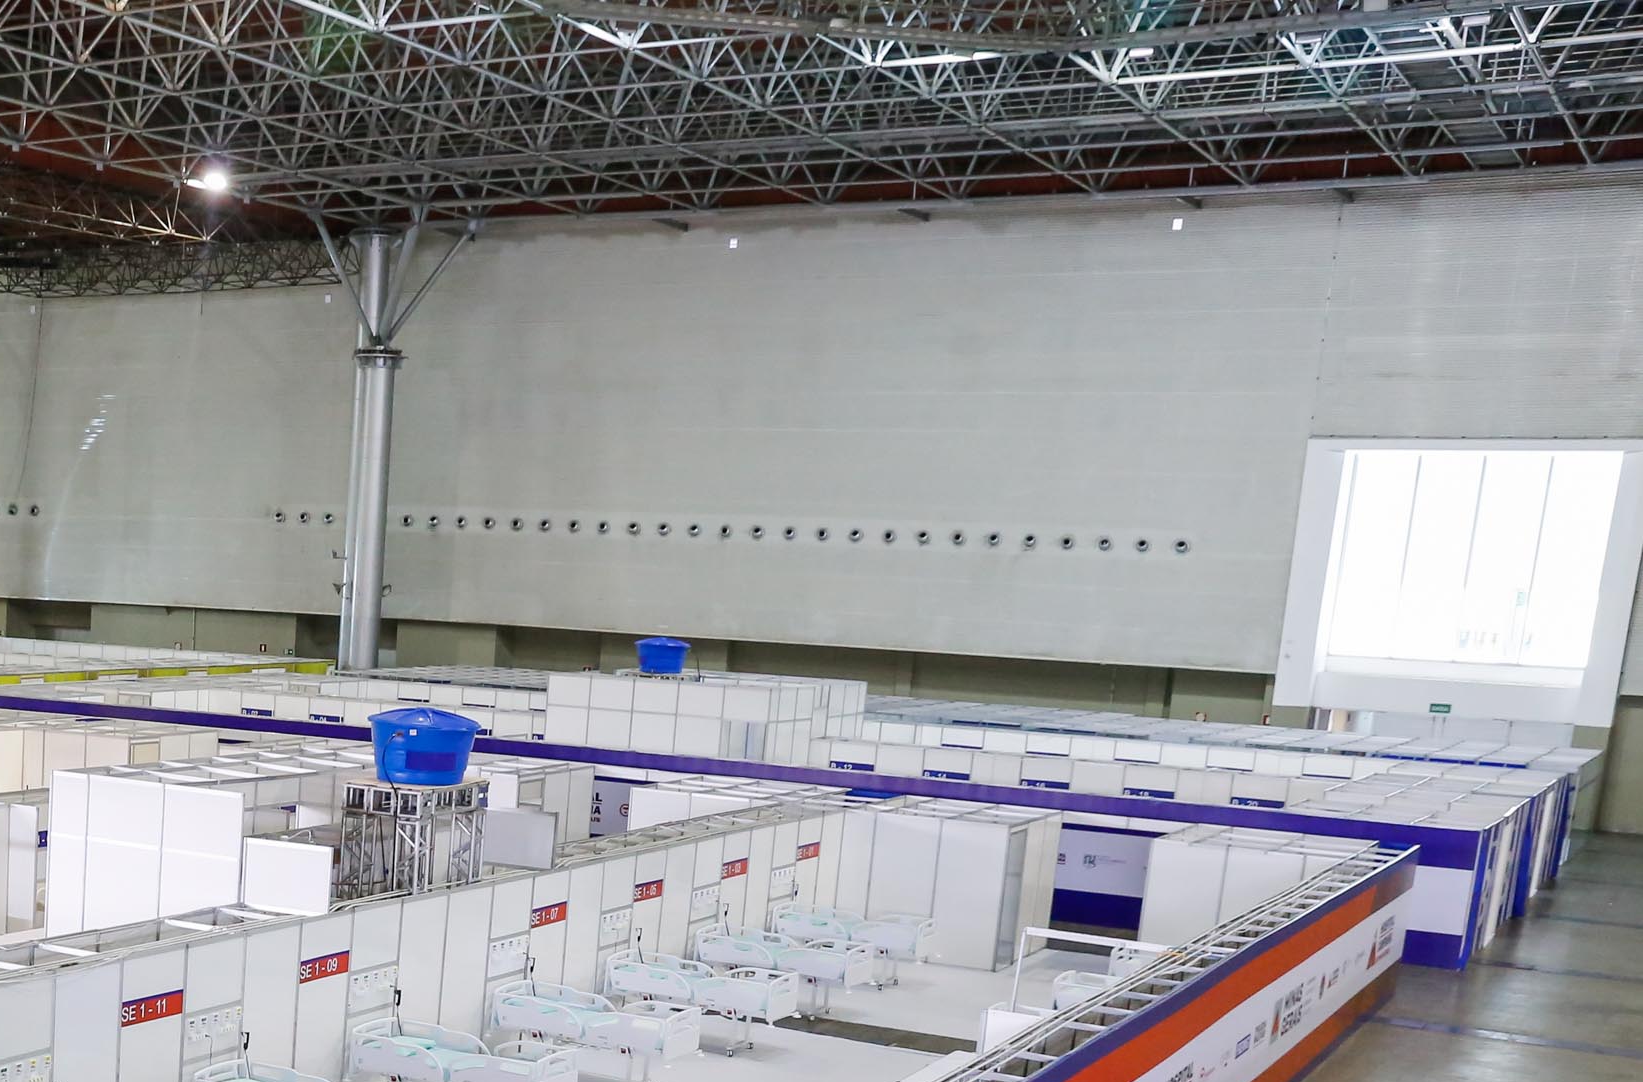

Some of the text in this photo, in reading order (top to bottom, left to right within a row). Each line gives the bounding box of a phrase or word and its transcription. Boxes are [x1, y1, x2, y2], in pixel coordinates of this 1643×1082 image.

[531, 911, 540, 925] SE
[542, 911, 545, 922] 1
[550, 907, 559, 920] 07
[300, 964, 312, 979] SE
[315, 962, 319, 976] 1
[326, 957, 338, 972] 09
[122, 1005, 137, 1022] SE
[140, 1003, 145, 1018] 1
[156, 998, 166, 1014] 11
